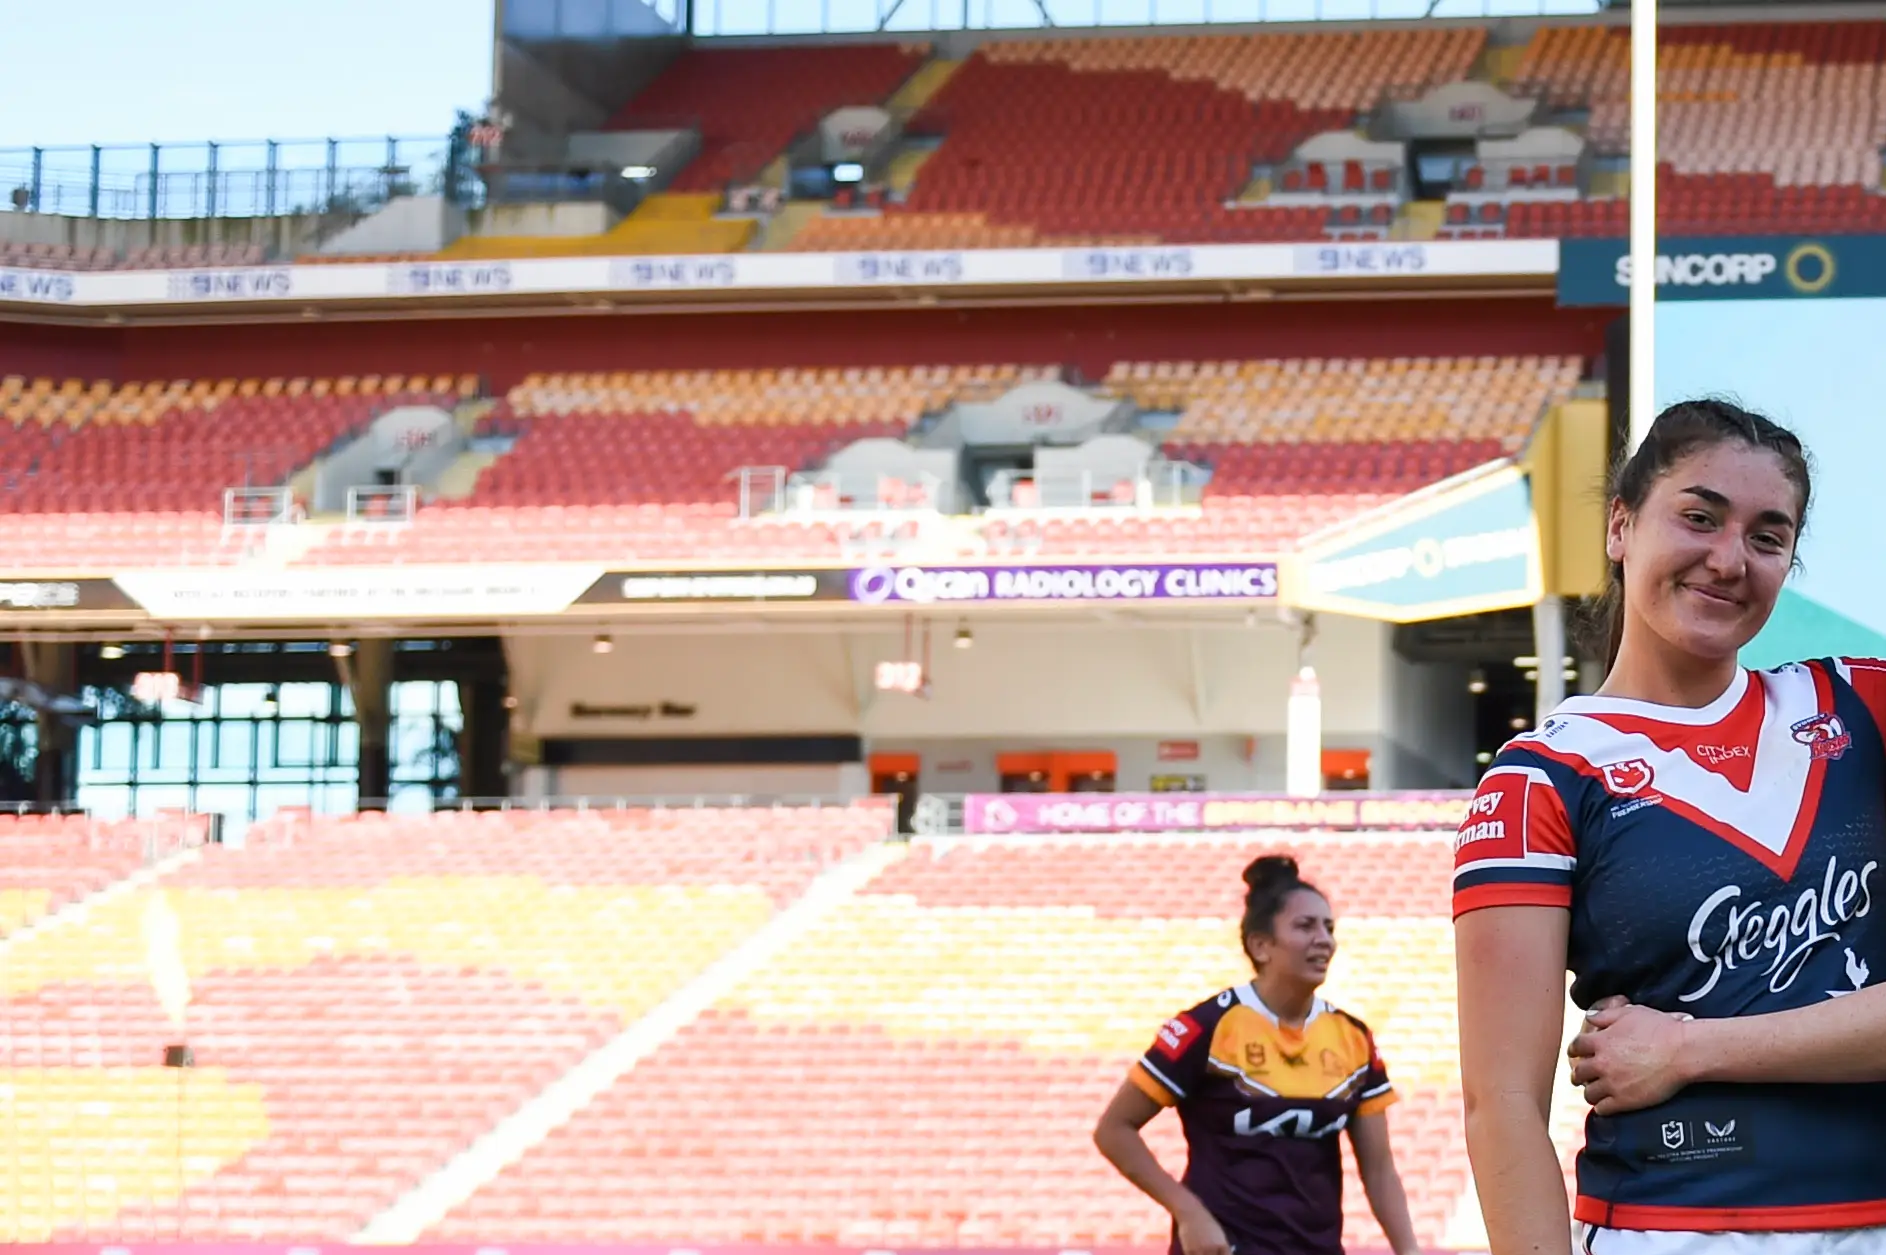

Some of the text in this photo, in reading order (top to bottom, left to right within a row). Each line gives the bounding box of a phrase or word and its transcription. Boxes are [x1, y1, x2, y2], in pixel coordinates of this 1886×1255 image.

[1616, 252, 1776, 287] SNCORP
[994, 568, 1160, 601] RADIOLOGY
[1164, 566, 1279, 599] CLINICS
[1696, 744, 1726, 757] CITY
[1708, 745, 1752, 765] INDEX
[1678, 855, 1878, 1003] Steggles
